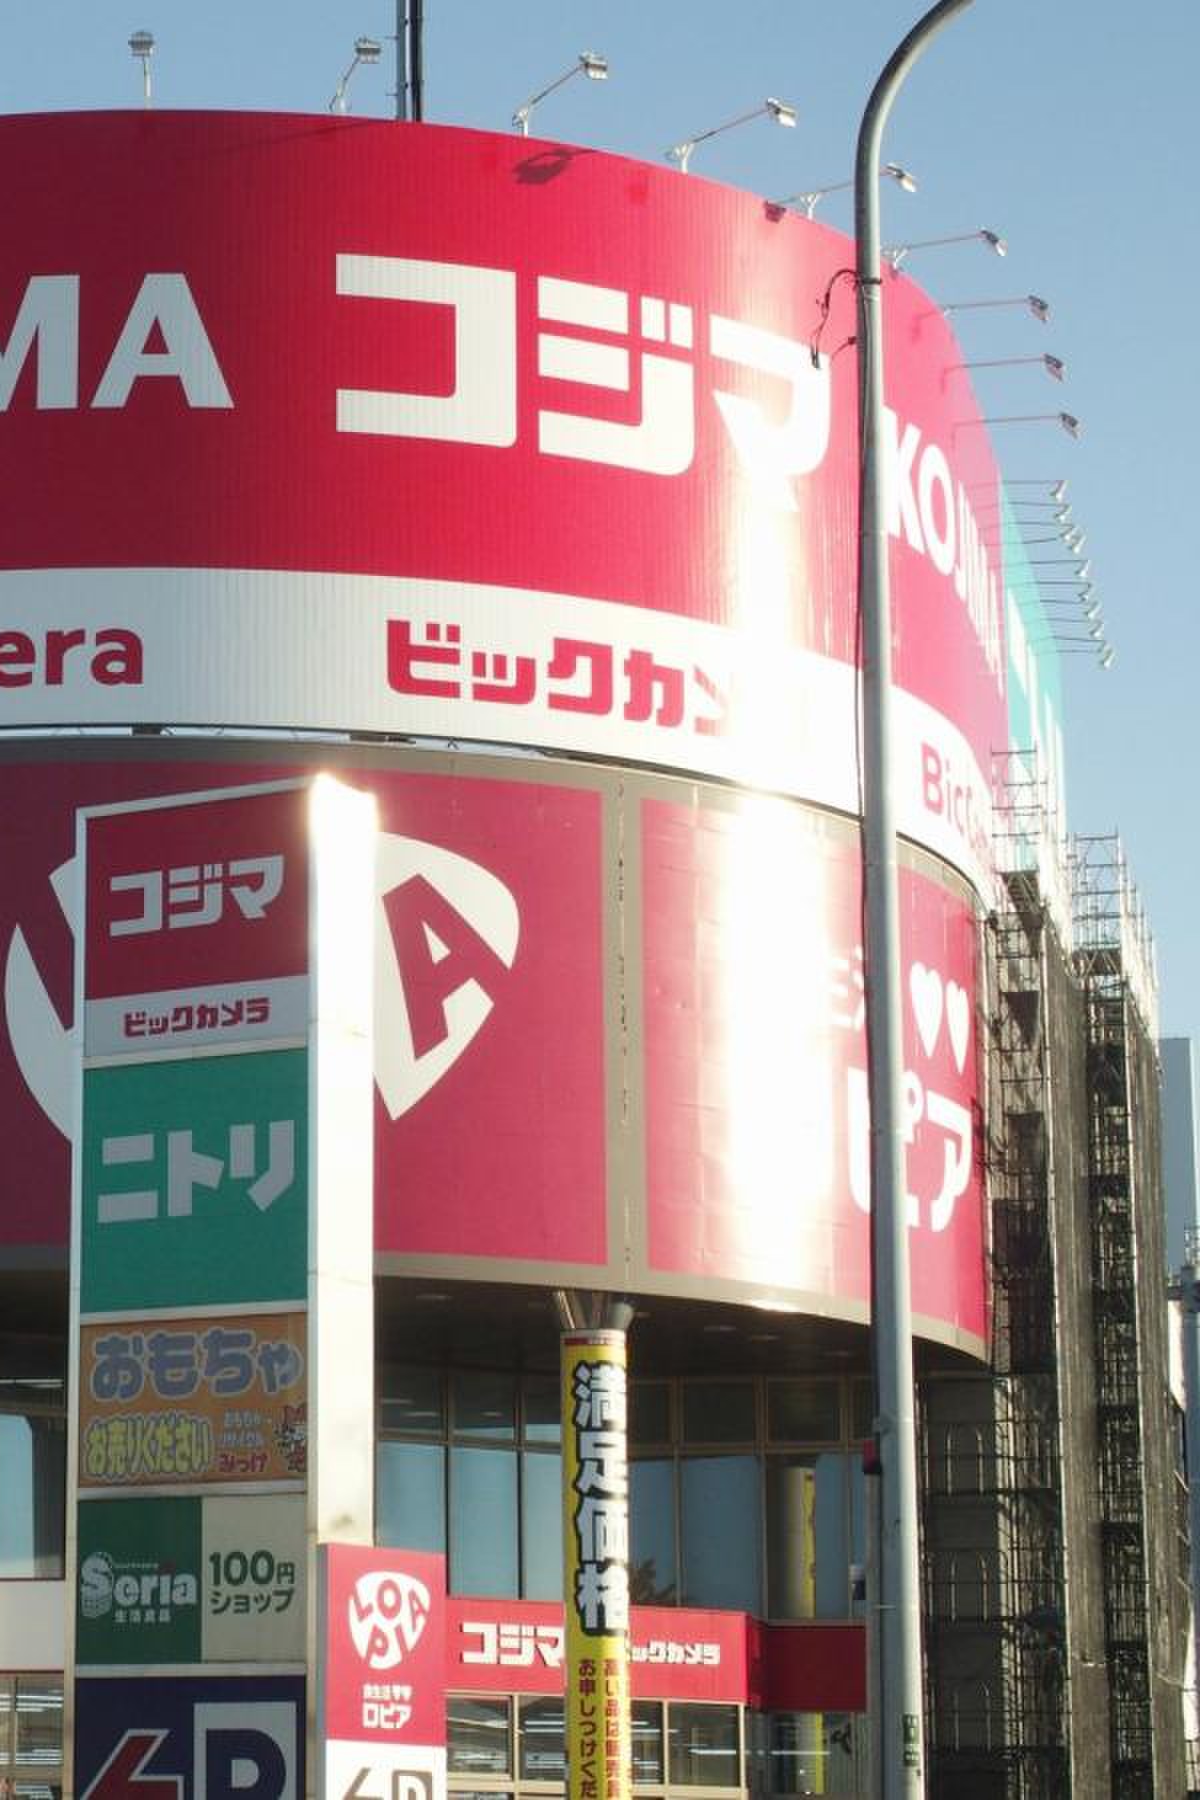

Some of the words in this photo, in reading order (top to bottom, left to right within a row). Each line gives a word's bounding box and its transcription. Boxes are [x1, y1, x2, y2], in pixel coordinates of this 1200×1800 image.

[336, 253, 831, 513] コジマ
[387, 619, 730, 737] ビックカ
[109, 855, 284, 936] コジマ
[123, 997, 271, 1038] ビックカメラ
[98, 1119, 294, 1223] ニトリ
[91, 1327, 304, 1402] おもちゃ
[81, 1552, 198, 1619] Seria
[209, 1550, 295, 1586] 100円
[211, 1588, 294, 1615] ショップ
[627, 1640, 721, 1665] ックカメラ
[362, 1702, 412, 1729] ロピア
